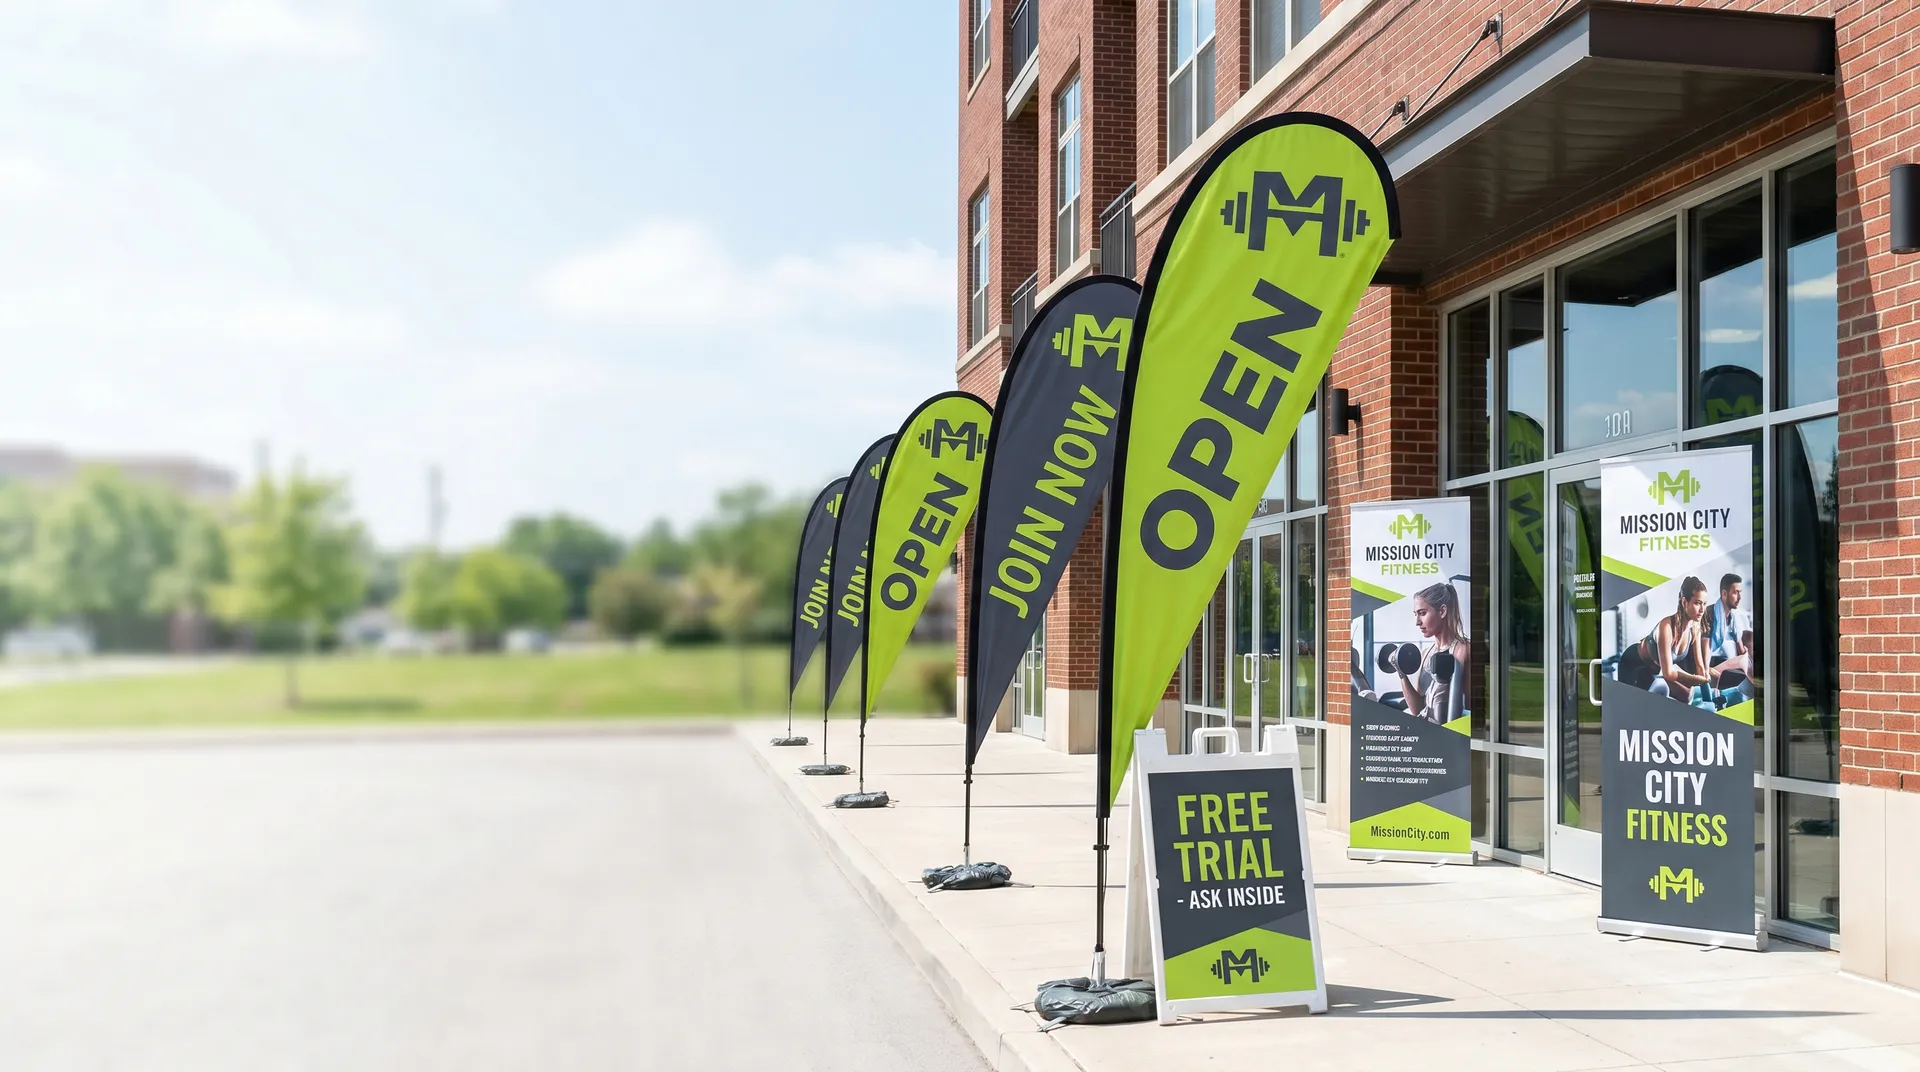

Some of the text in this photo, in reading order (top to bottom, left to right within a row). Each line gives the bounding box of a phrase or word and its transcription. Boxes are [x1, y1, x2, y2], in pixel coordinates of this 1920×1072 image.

[1139, 278, 1323, 570] OPEN
[988, 384, 1117, 619] JOIN NOW
[1620, 507, 1731, 534] MISSION CITY
[880, 471, 969, 611] OPEN
[1366, 543, 1455, 561] MISSION CITY
[1639, 534, 1711, 551] FITNESS
[1381, 562, 1439, 575] FITNESS
[800, 578, 829, 629] JOIN
[837, 565, 866, 627] JOIN
[1619, 729, 1734, 767] MISSION
[1645, 769, 1707, 806] CITY
[1177, 791, 1273, 836] FREE
[1626, 808, 1728, 847] FITNESS
[1370, 825, 1450, 842] MissionCity.com
[1173, 837, 1284, 883] TRIAL
[1189, 887, 1223, 910] ASK
[1227, 885, 1286, 907] INSIDE
